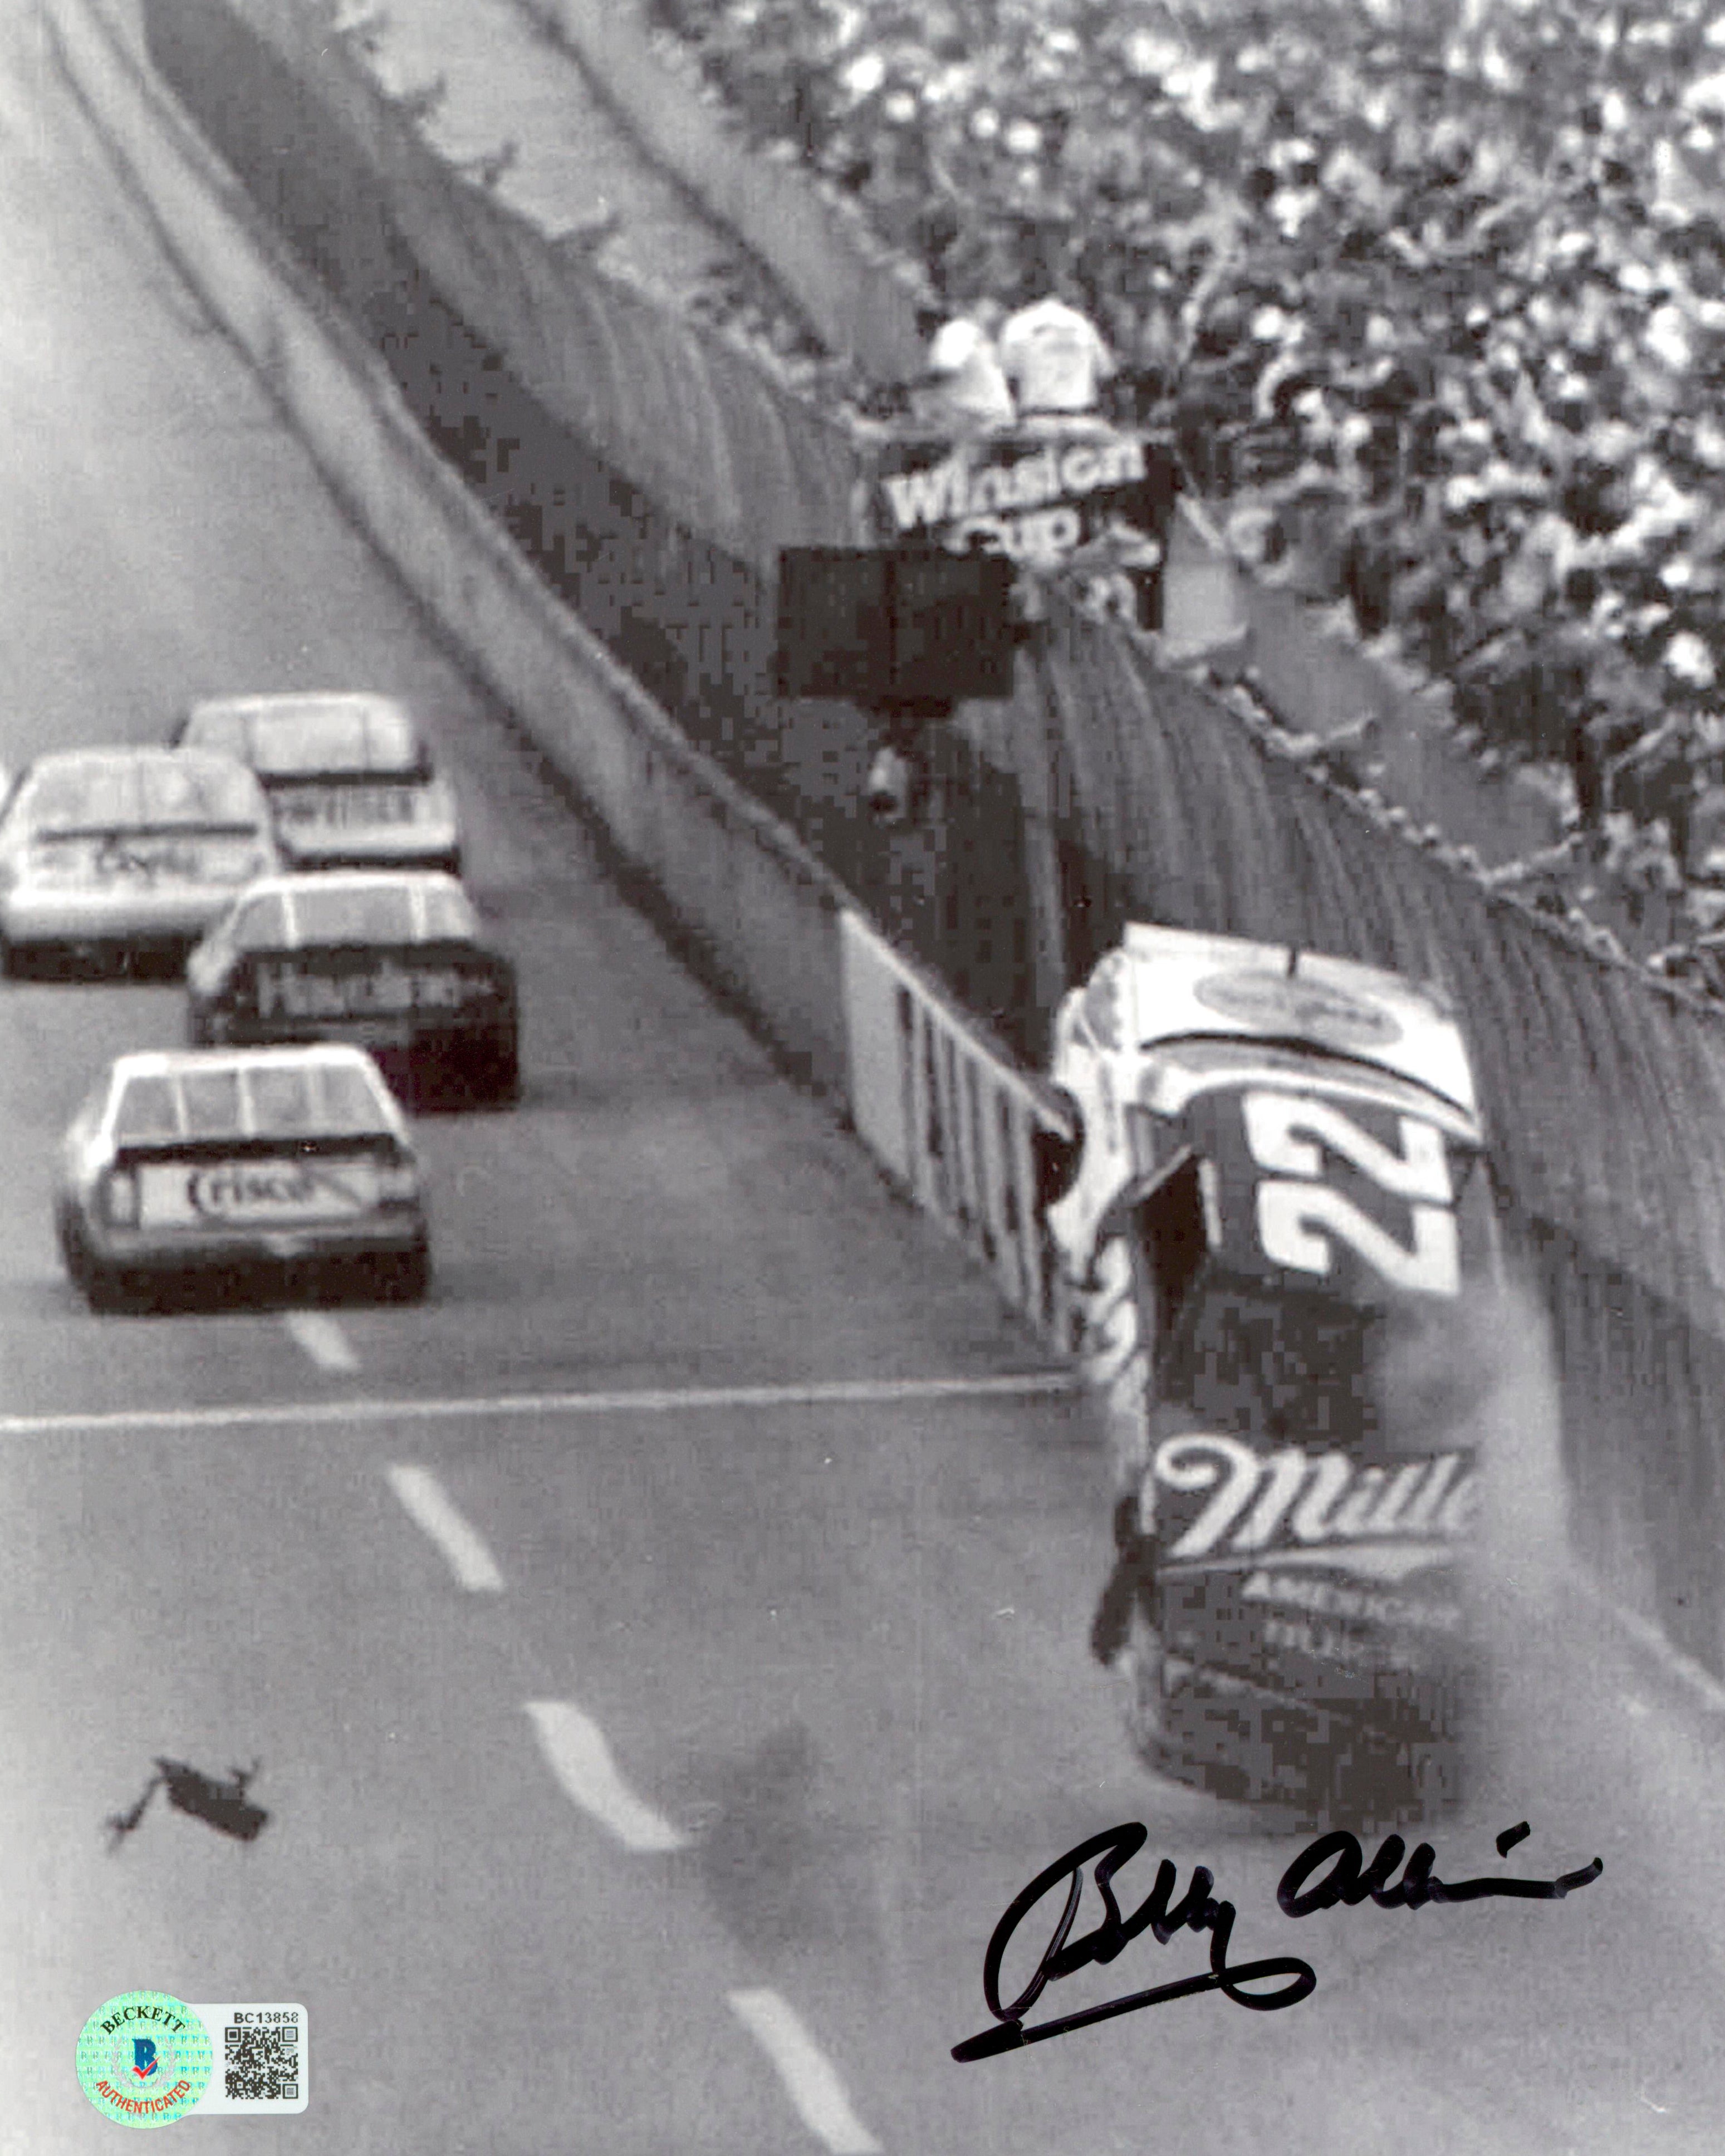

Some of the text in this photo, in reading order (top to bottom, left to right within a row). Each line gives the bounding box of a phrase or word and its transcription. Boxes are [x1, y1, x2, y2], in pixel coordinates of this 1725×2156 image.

[1242, 1091, 1461, 1294] 22
[100, 2006, 186, 2035] BECKETT
[233, 2012, 299, 2023] BC13858
[96, 2080, 191, 2114] AUTHENTICATED
